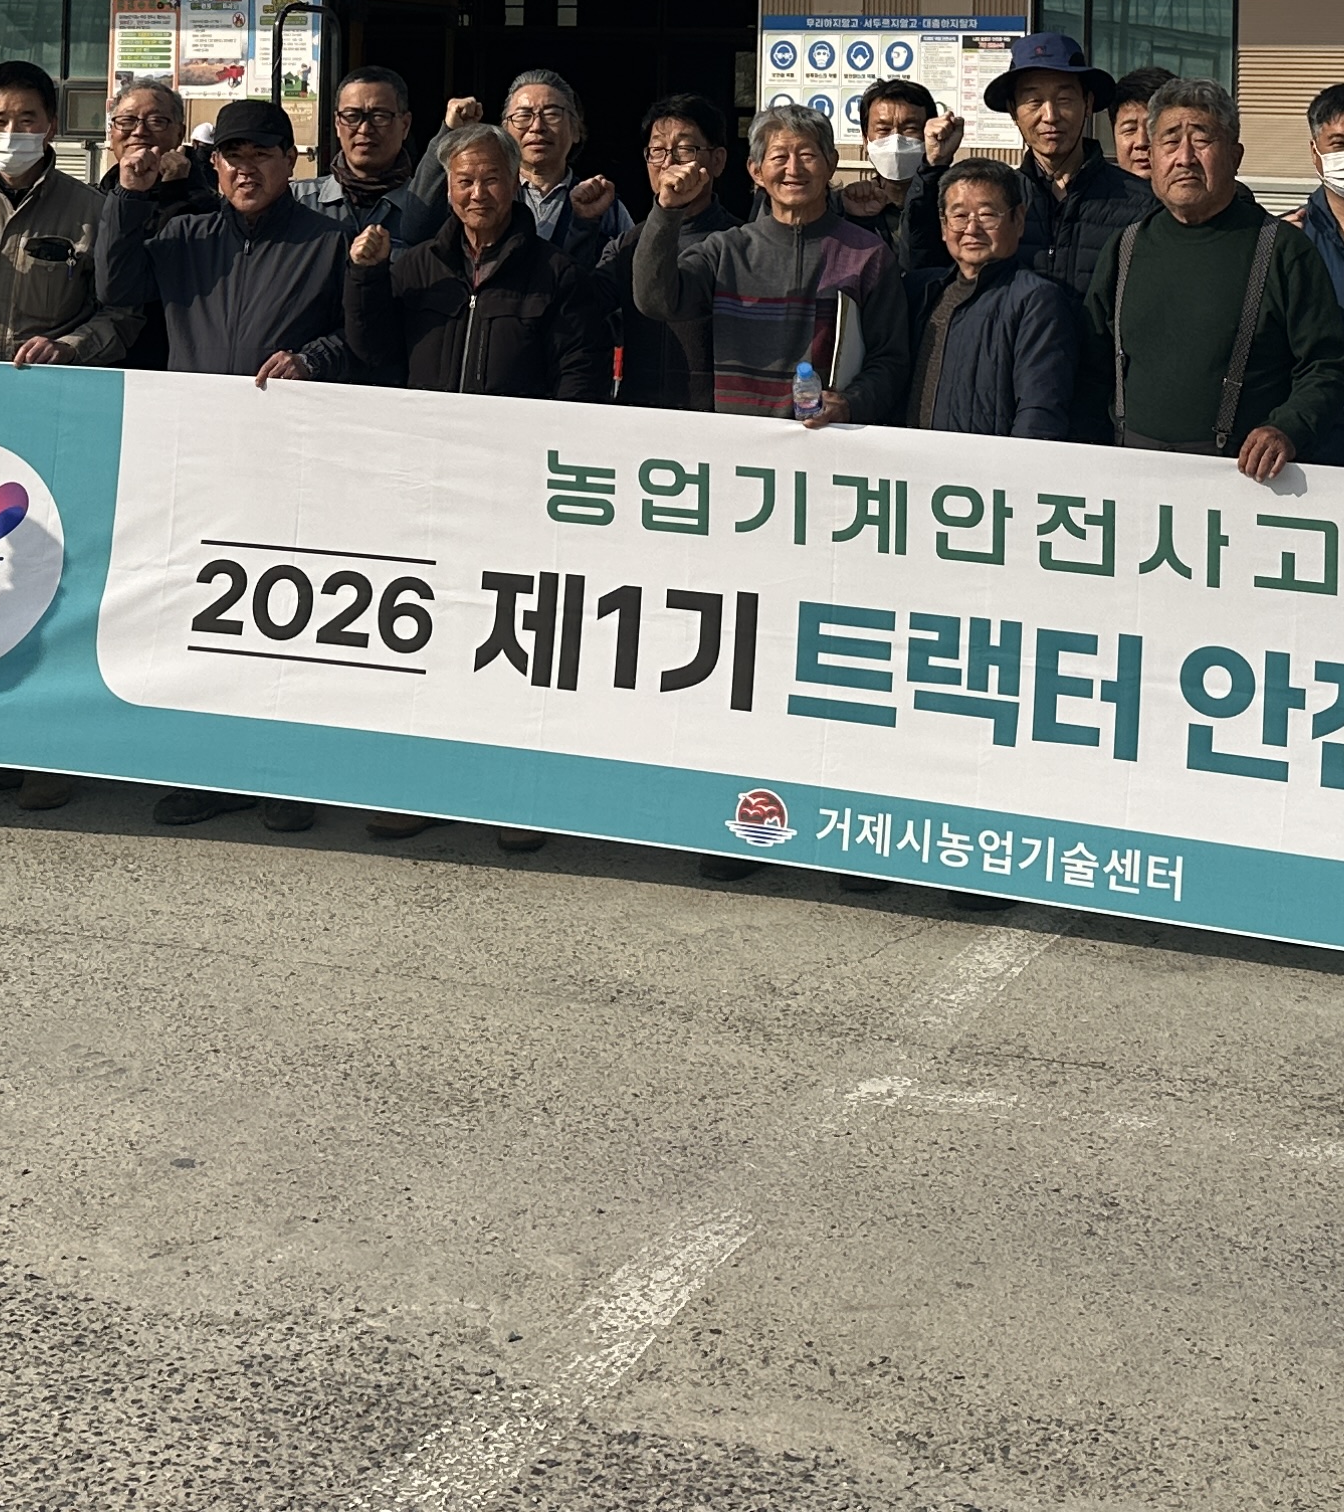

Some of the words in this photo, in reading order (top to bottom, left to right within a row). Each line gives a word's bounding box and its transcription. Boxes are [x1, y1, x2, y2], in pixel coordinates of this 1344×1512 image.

[191, 558, 435, 655] 2026
[474, 571, 759, 712] 제1기
[787, 598, 1144, 762] 트랙터
[816, 805, 1184, 903] 거제시농업기술센터
